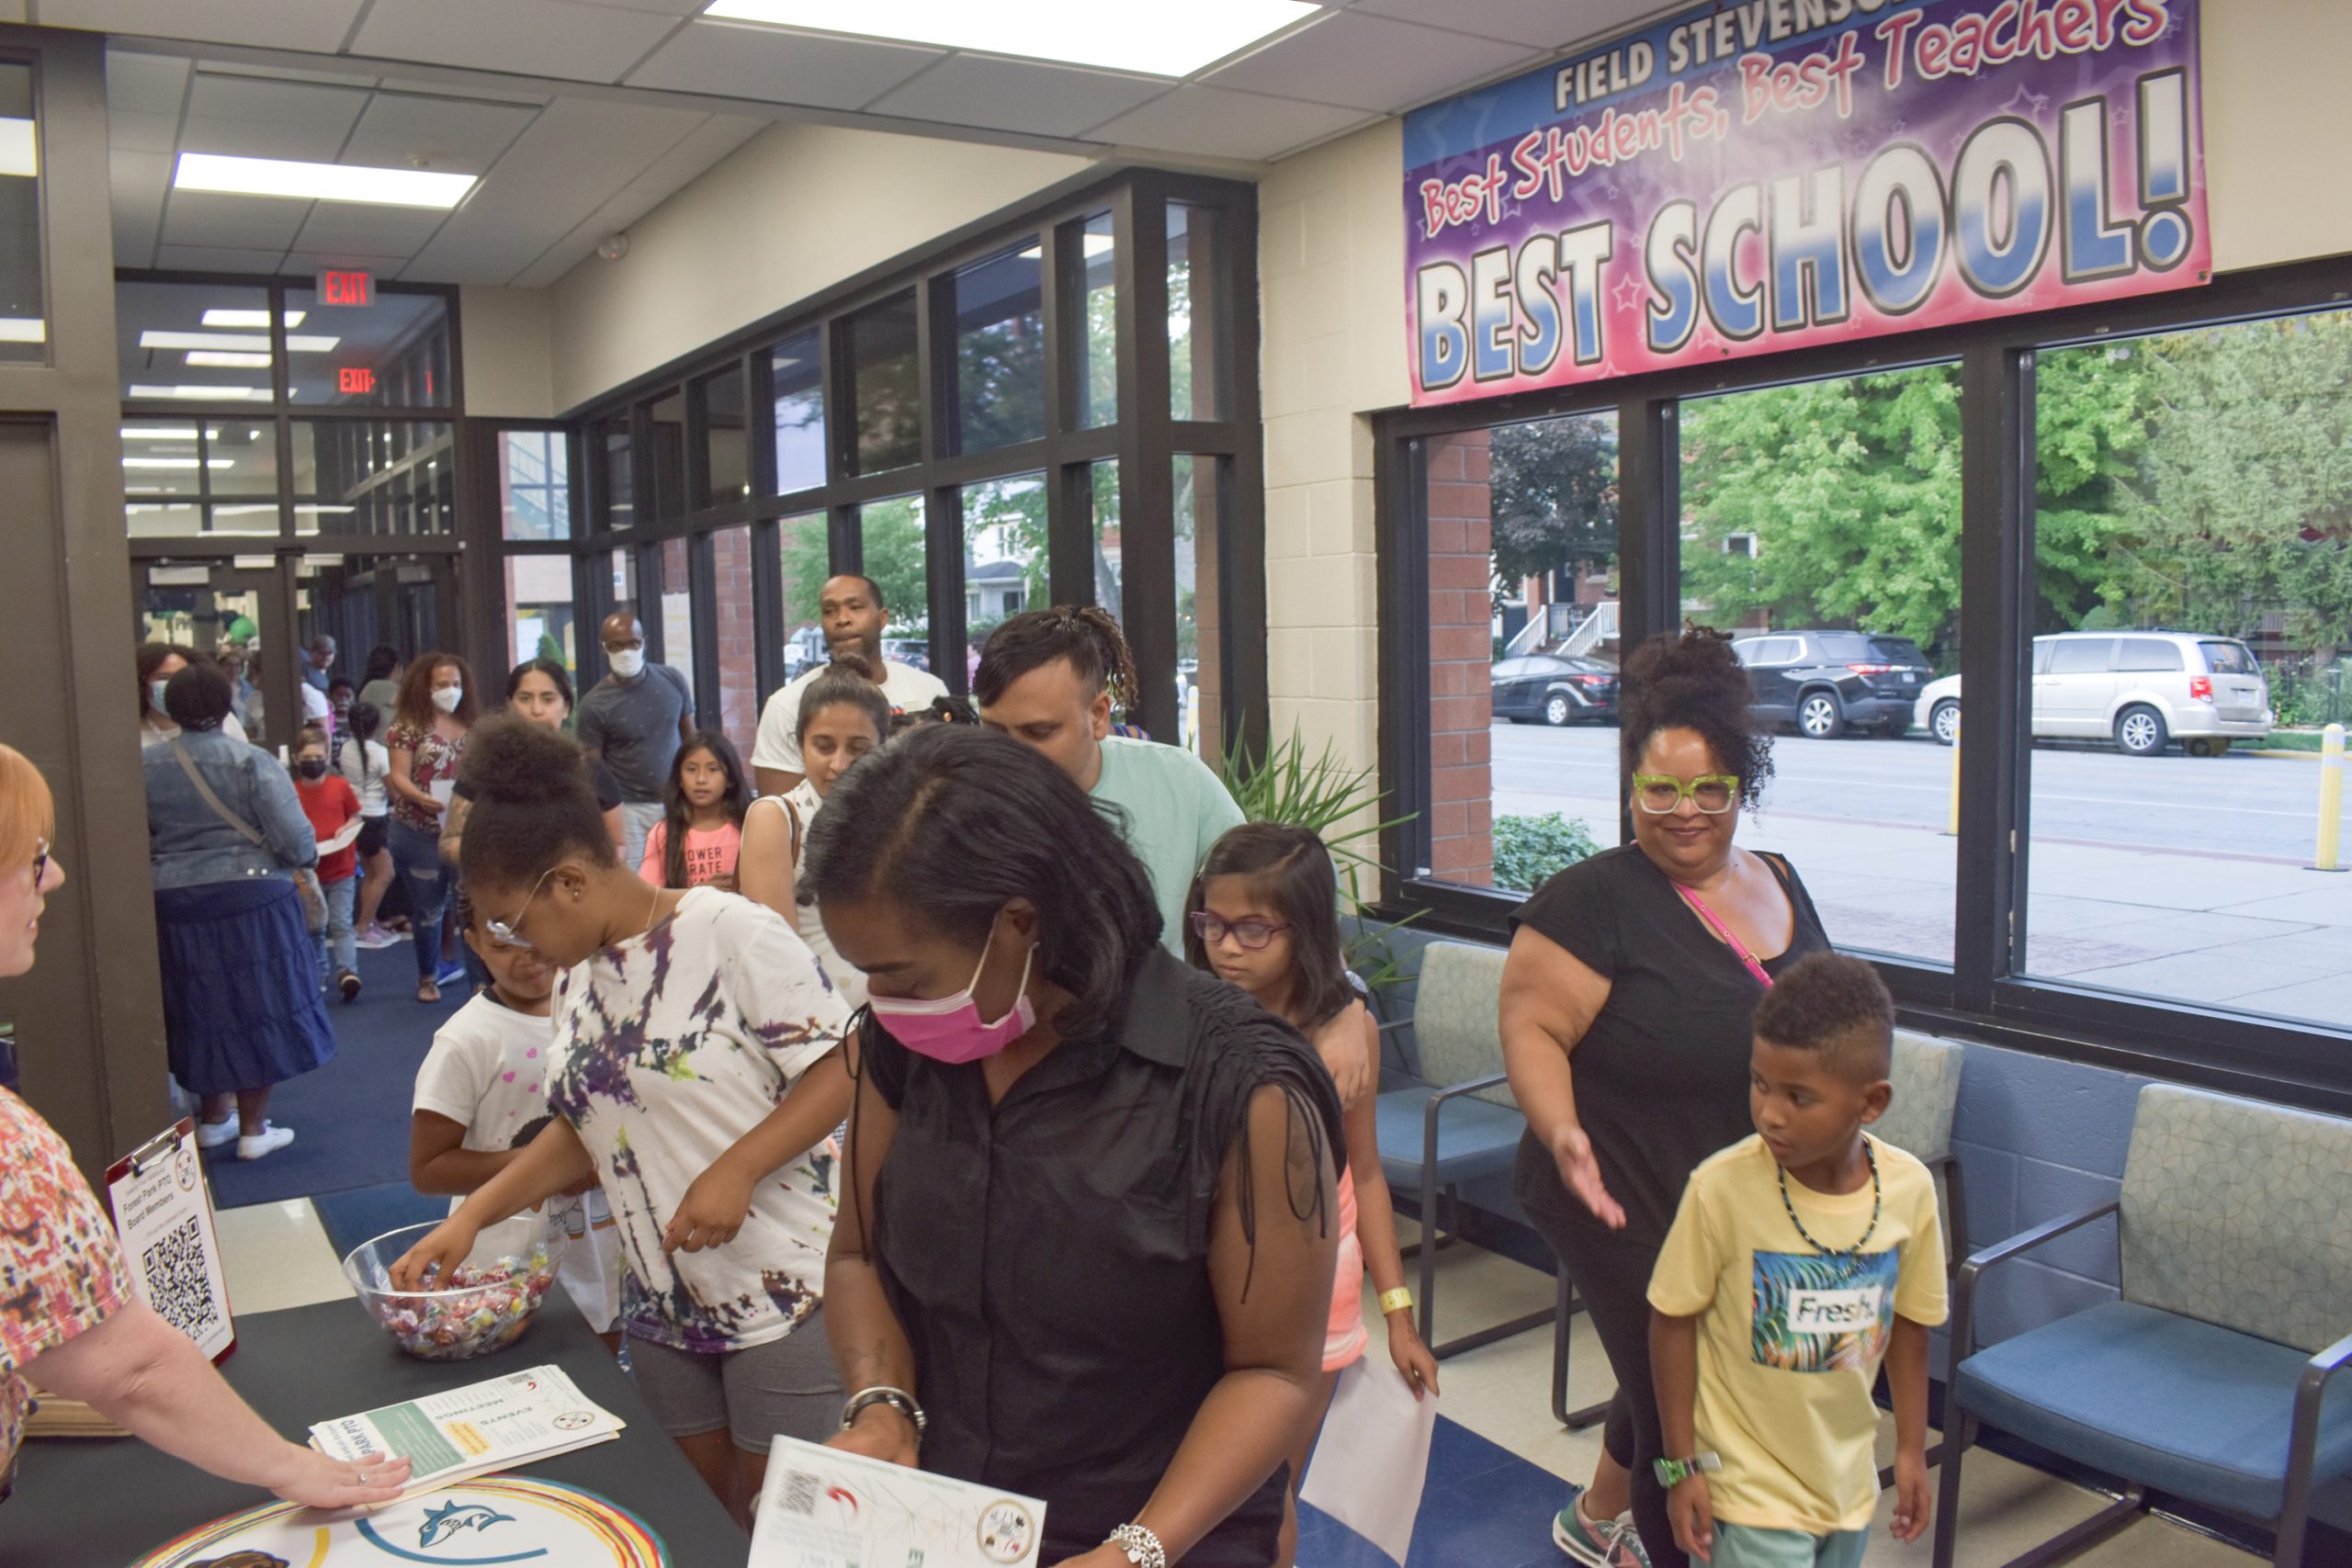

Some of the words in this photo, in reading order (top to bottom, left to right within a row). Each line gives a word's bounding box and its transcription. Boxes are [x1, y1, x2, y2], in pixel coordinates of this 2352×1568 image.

[1555, 40, 1655, 111] FIELD
[1668, 0, 1905, 73] STEVENS
[1420, 167, 1507, 238] Best
[1510, 81, 1729, 204] Students,
[1737, 30, 1865, 126] Best
[1875, 0, 2169, 90] Teachers
[1416, 220, 1613, 393] BEST
[1643, 65, 2193, 355] SCHOOL!
[325, 270, 368, 305] EXIT
[339, 367, 371, 393] EXIT
[687, 847, 722, 862] OWER
[689, 862, 722, 875] RATE
[157, 1174, 173, 1190] PTO
